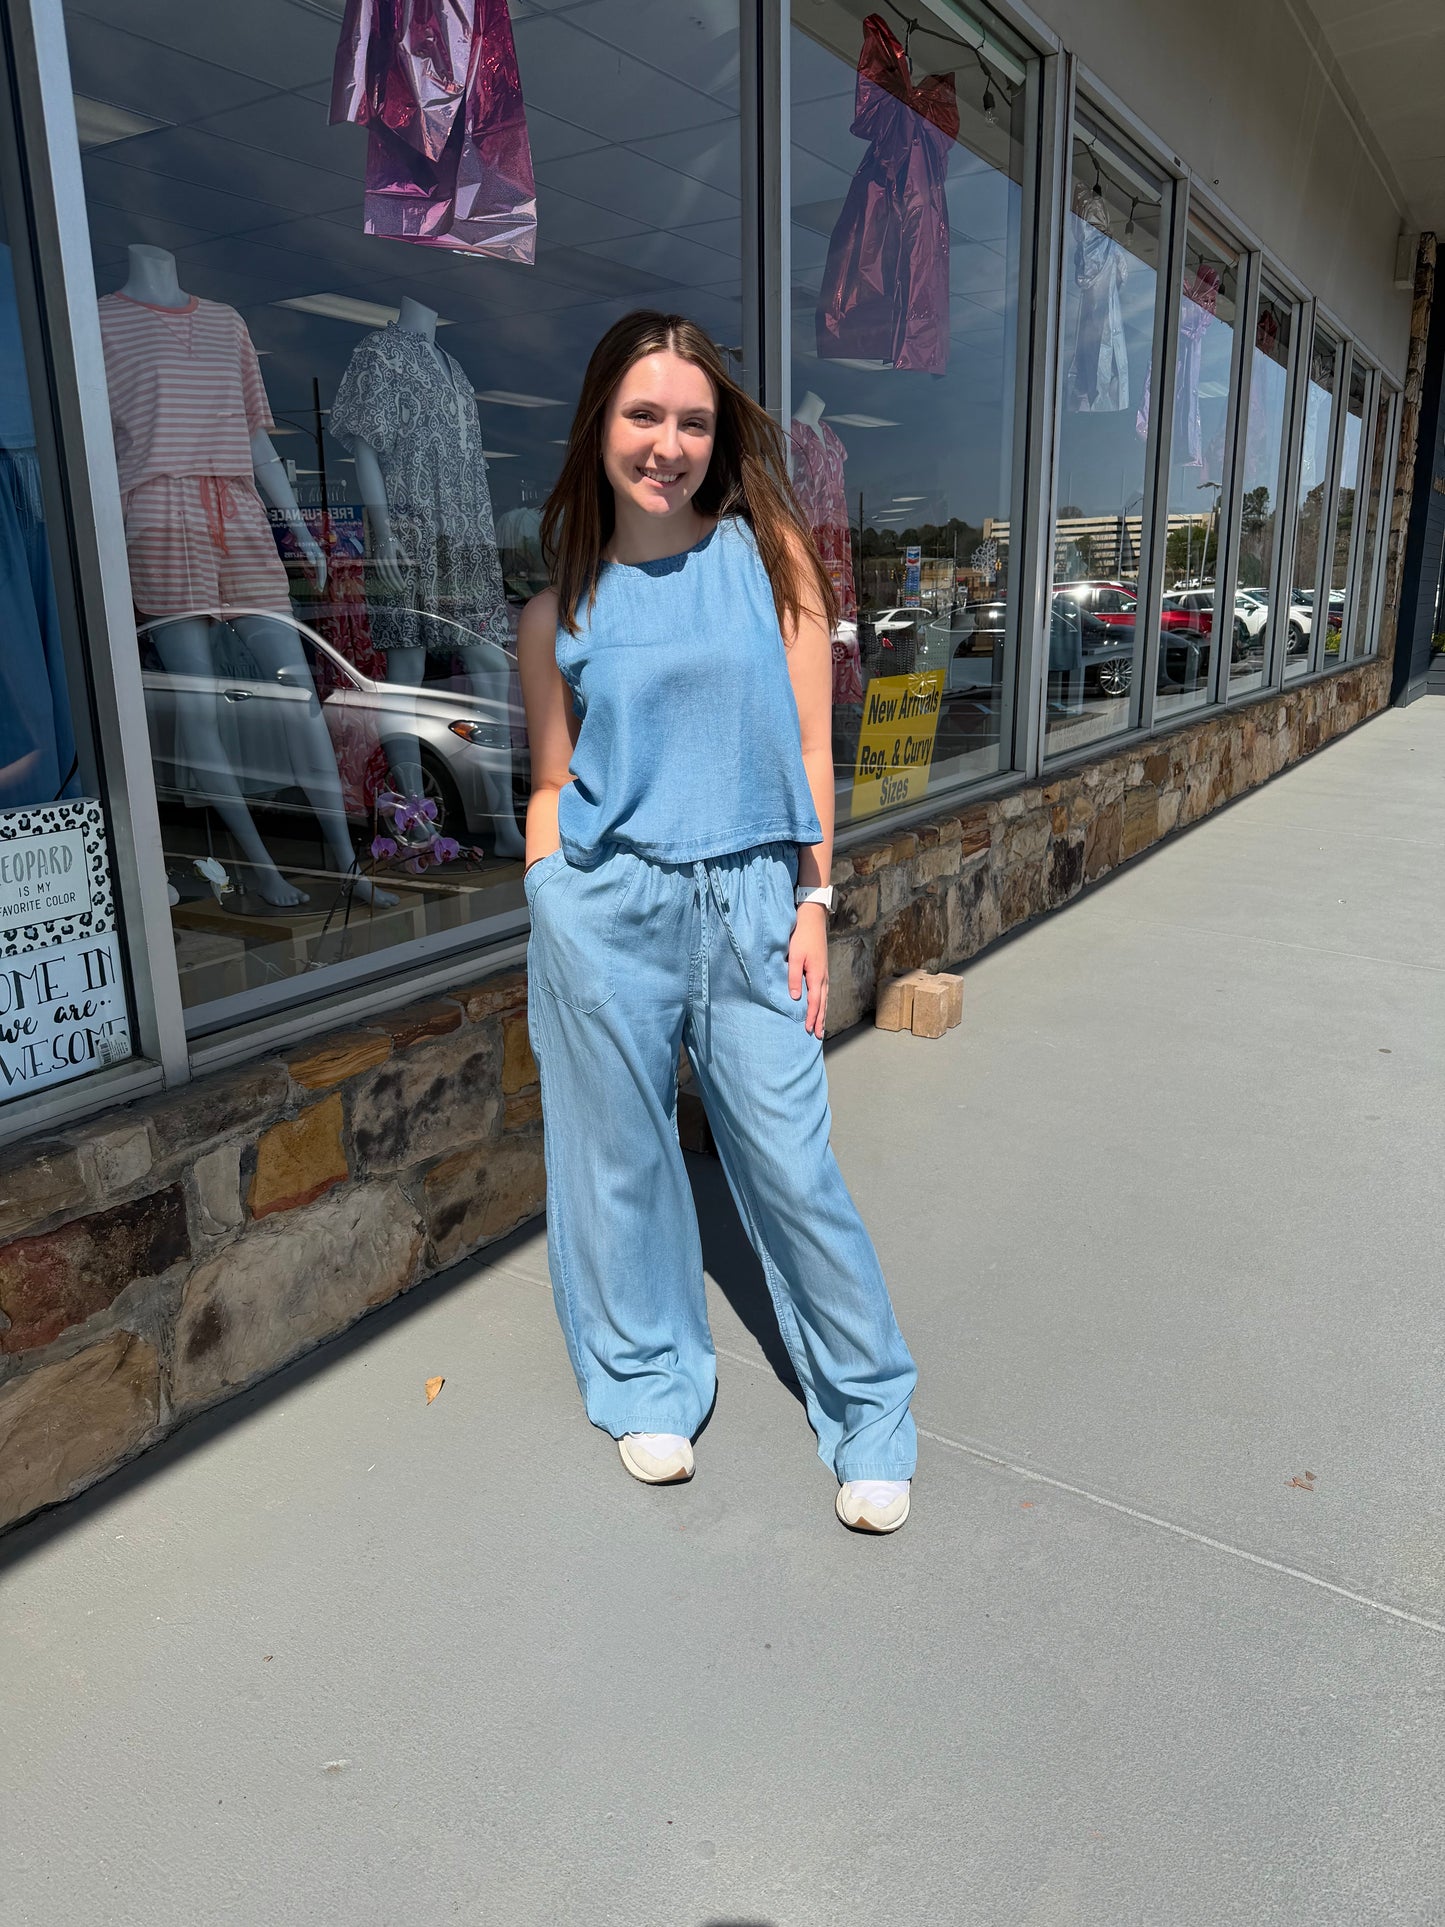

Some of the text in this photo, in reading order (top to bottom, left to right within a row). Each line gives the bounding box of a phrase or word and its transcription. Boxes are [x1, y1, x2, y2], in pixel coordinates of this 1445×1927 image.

[867, 685, 940, 725] New Arrivals
[859, 736, 932, 780] Reg. & Curvy
[880, 775, 909, 807] Sizes
[0, 845, 73, 886] EOPARD
[18, 881, 51, 898] IS MY
[46, 892, 76, 908] COLOR
[78, 946, 117, 993] IN
